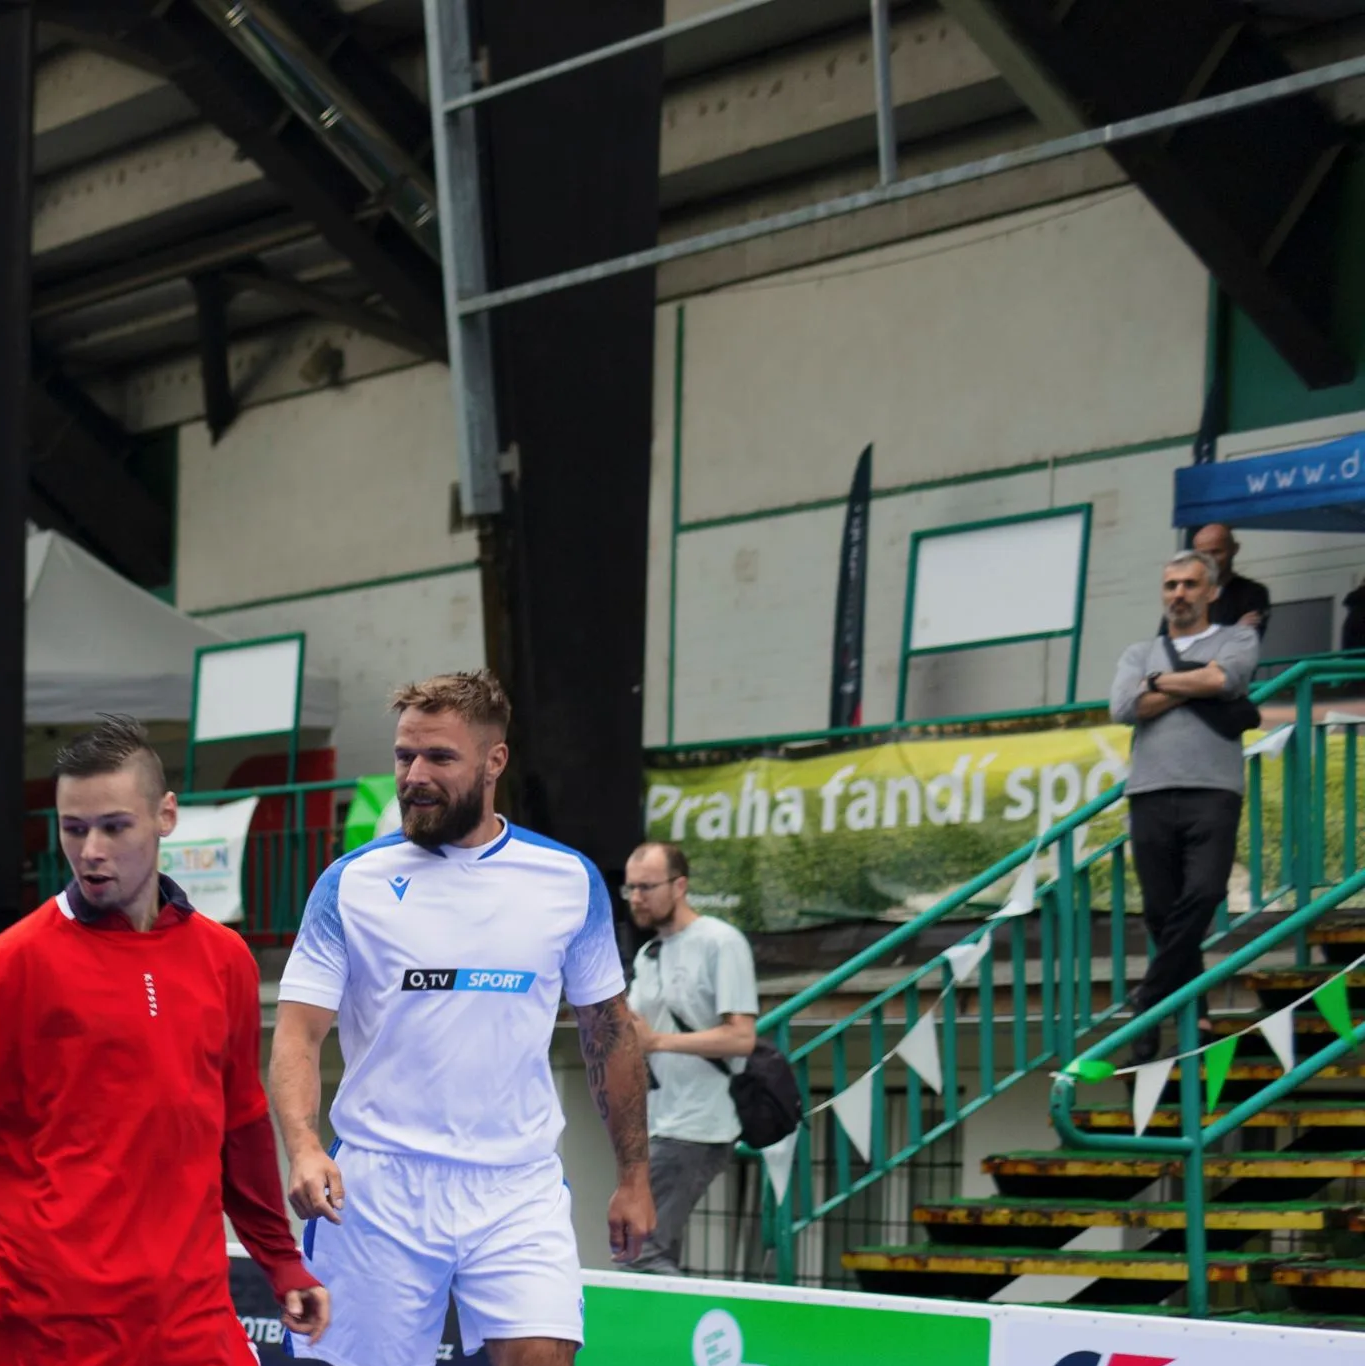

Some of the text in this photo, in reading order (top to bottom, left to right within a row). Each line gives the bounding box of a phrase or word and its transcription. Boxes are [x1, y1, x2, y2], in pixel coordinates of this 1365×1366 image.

[646, 770, 804, 842] Praha
[820, 751, 1000, 834] fandí
[467, 971, 524, 989] SPORT
